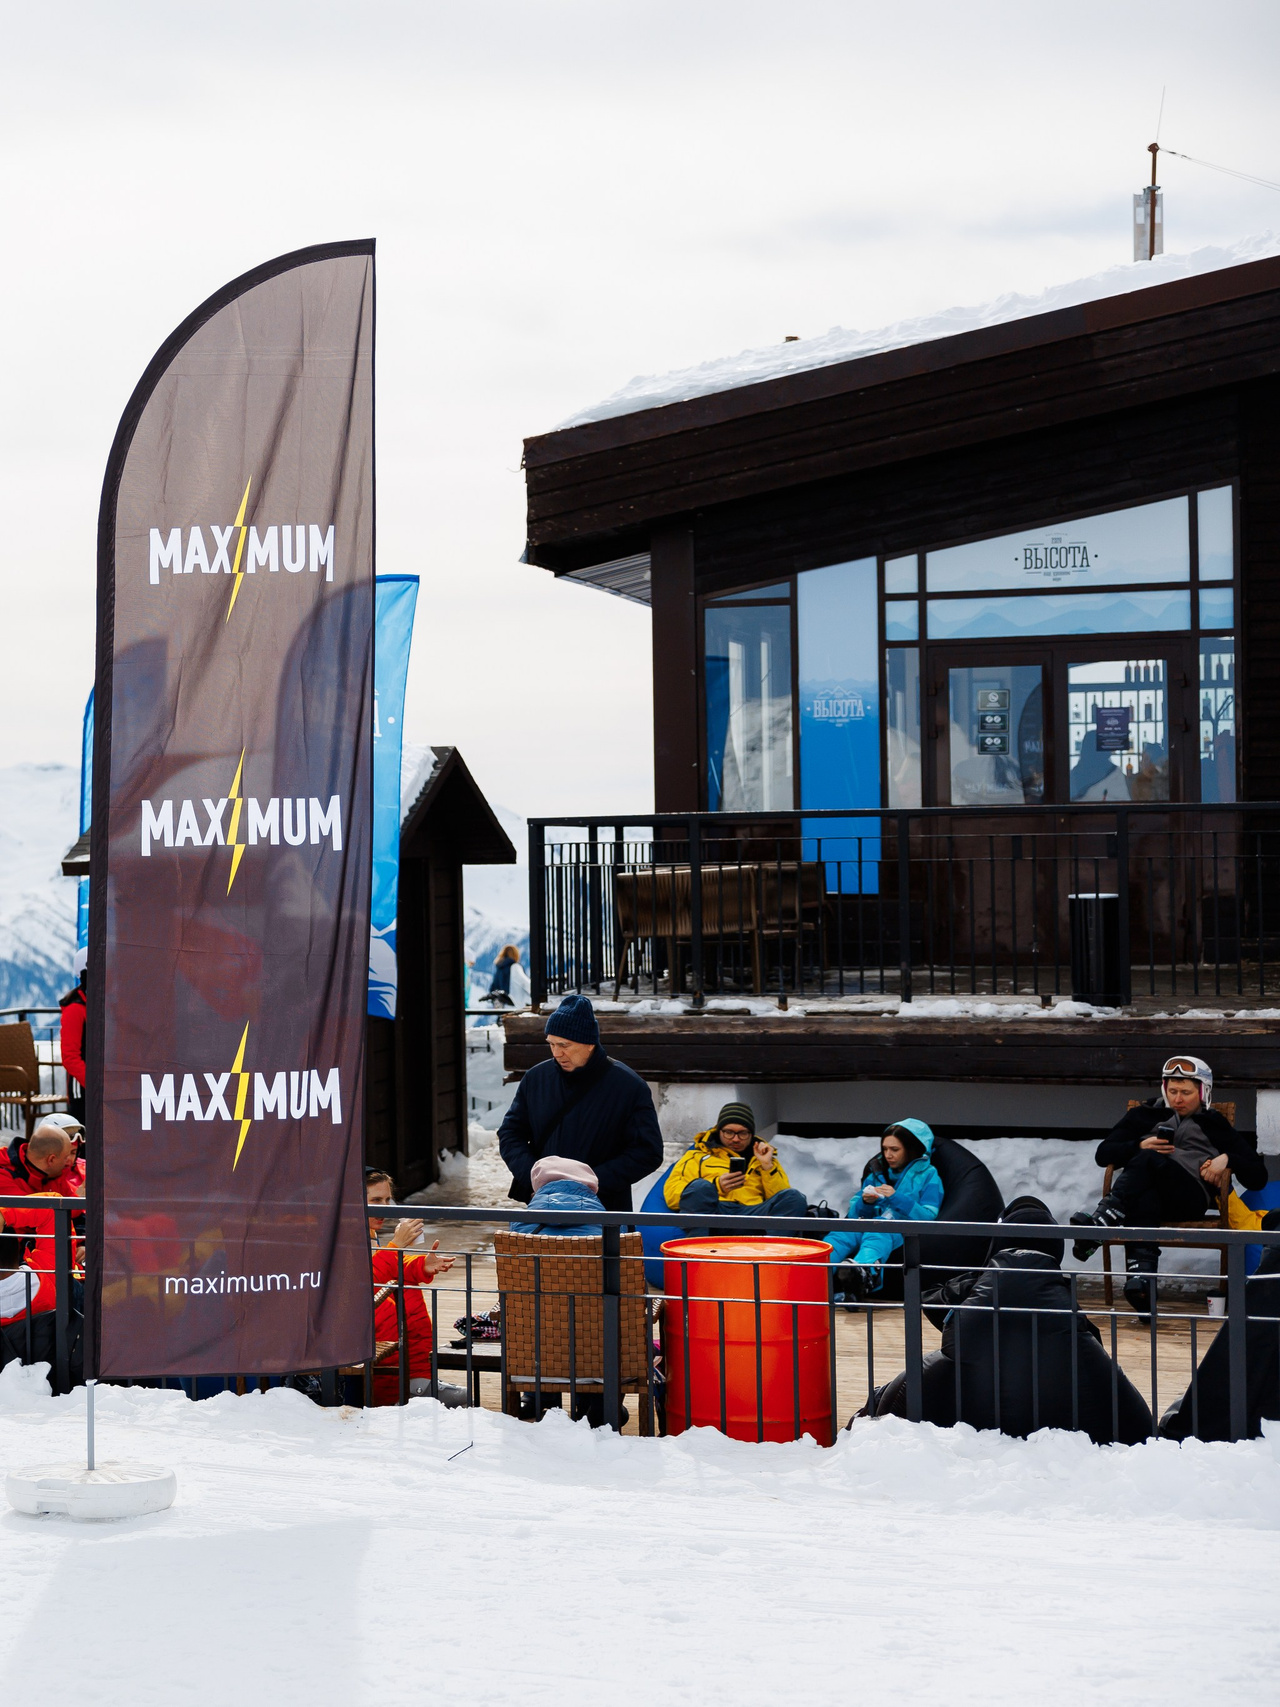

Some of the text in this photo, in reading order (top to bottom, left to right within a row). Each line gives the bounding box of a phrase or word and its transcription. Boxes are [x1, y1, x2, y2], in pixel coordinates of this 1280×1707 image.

[1023, 545, 1090, 570] ВЫСОТА
[813, 699, 865, 718] ВЫСОТА
[165, 1270, 322, 1294] maximum.ru
